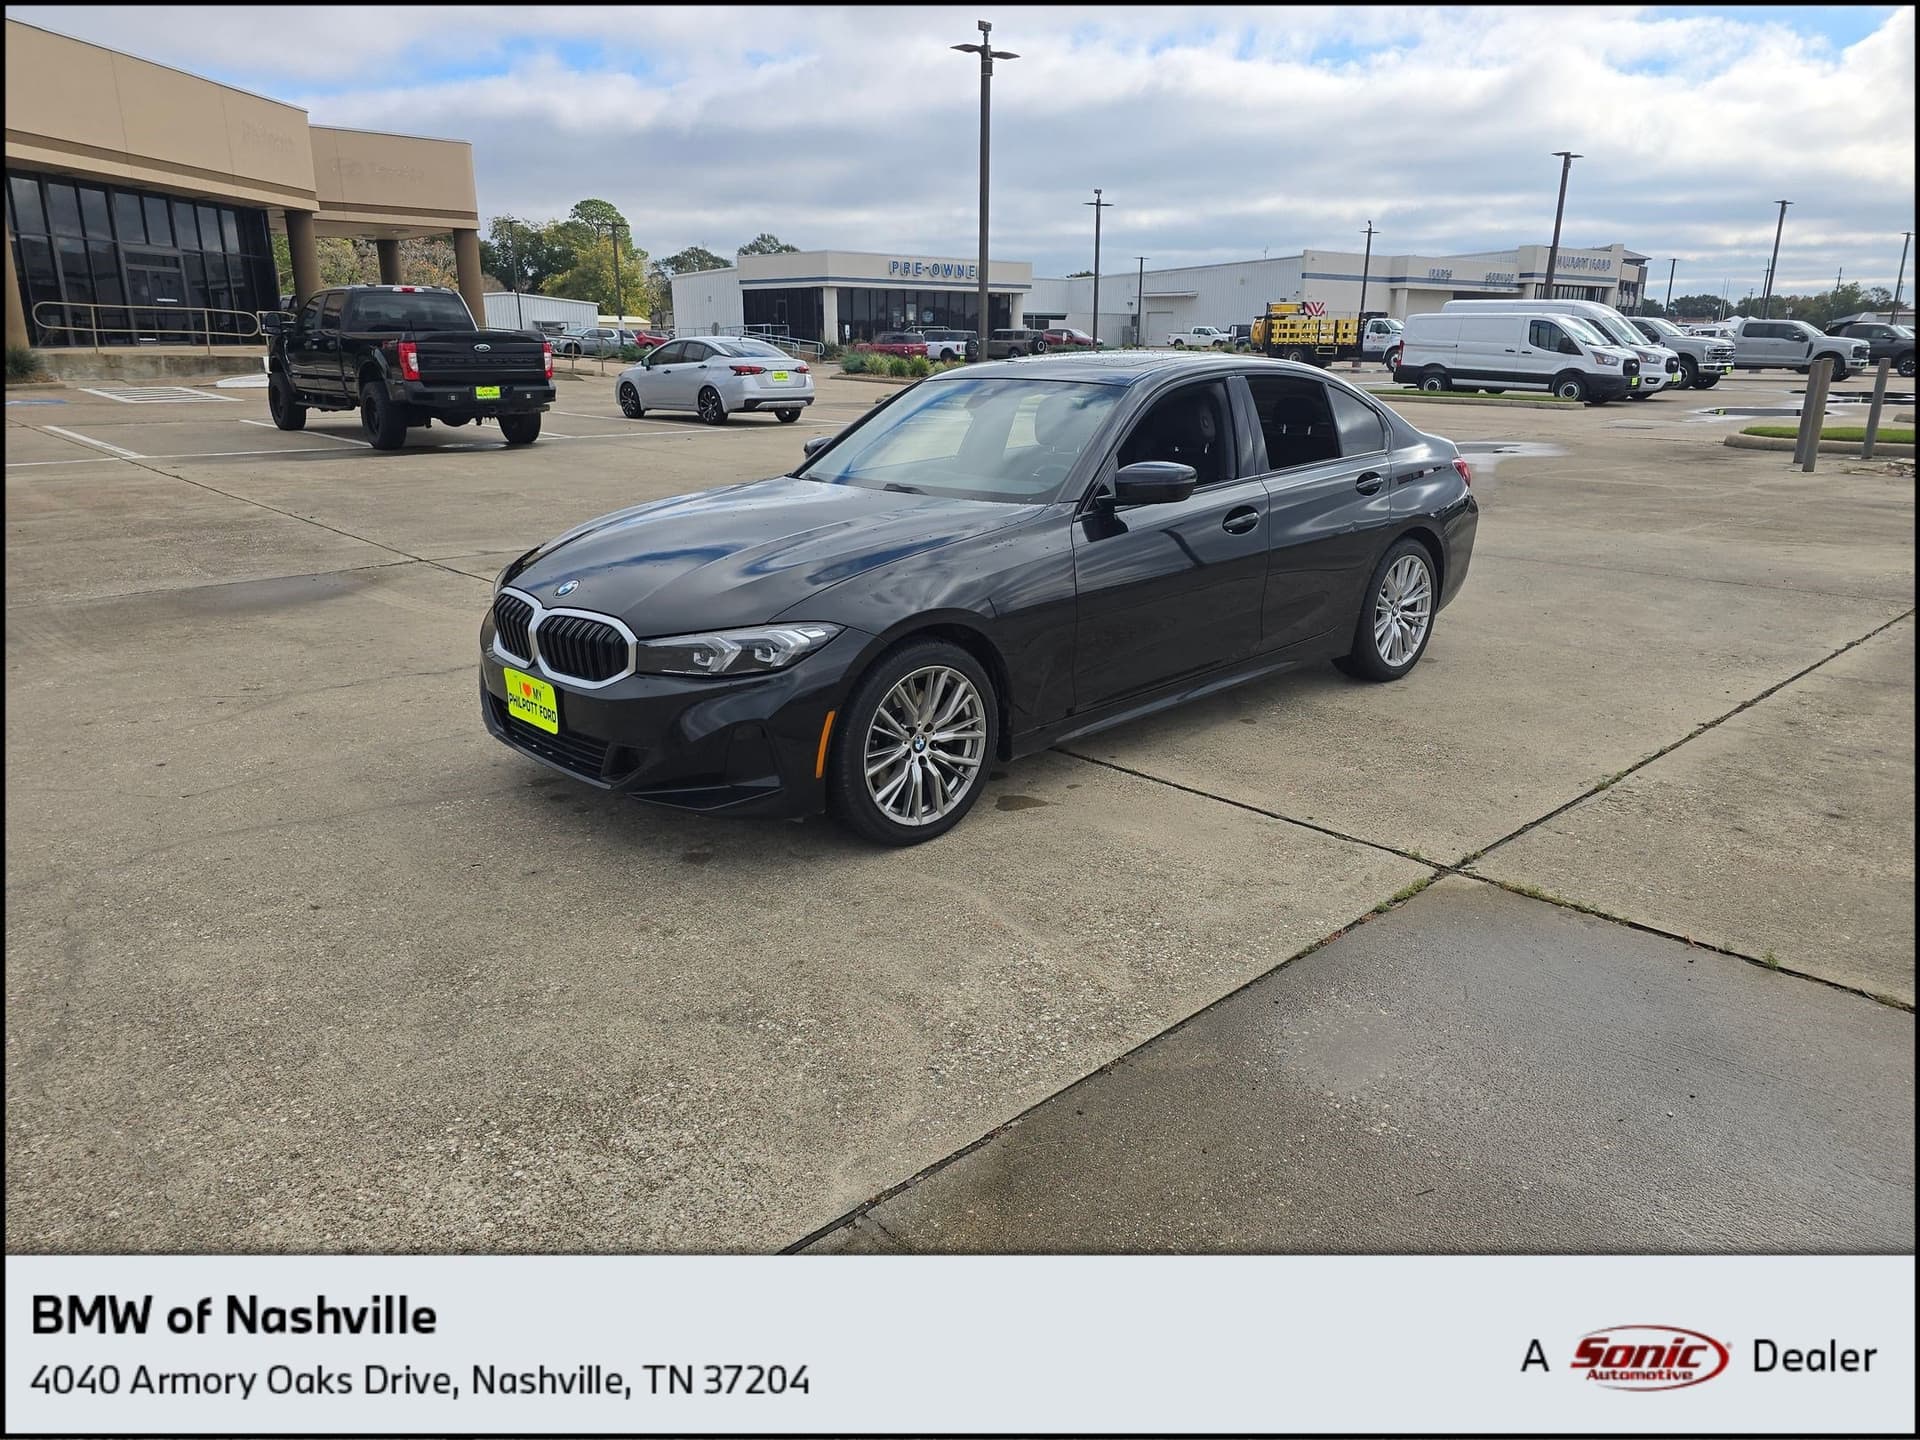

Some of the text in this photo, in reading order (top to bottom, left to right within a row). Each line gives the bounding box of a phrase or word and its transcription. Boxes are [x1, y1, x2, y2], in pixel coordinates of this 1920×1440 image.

[889, 261, 979, 279] PRE-OWNE
[532, 687, 543, 702] MY
[508, 692, 557, 723] PHILPOTT FORD
